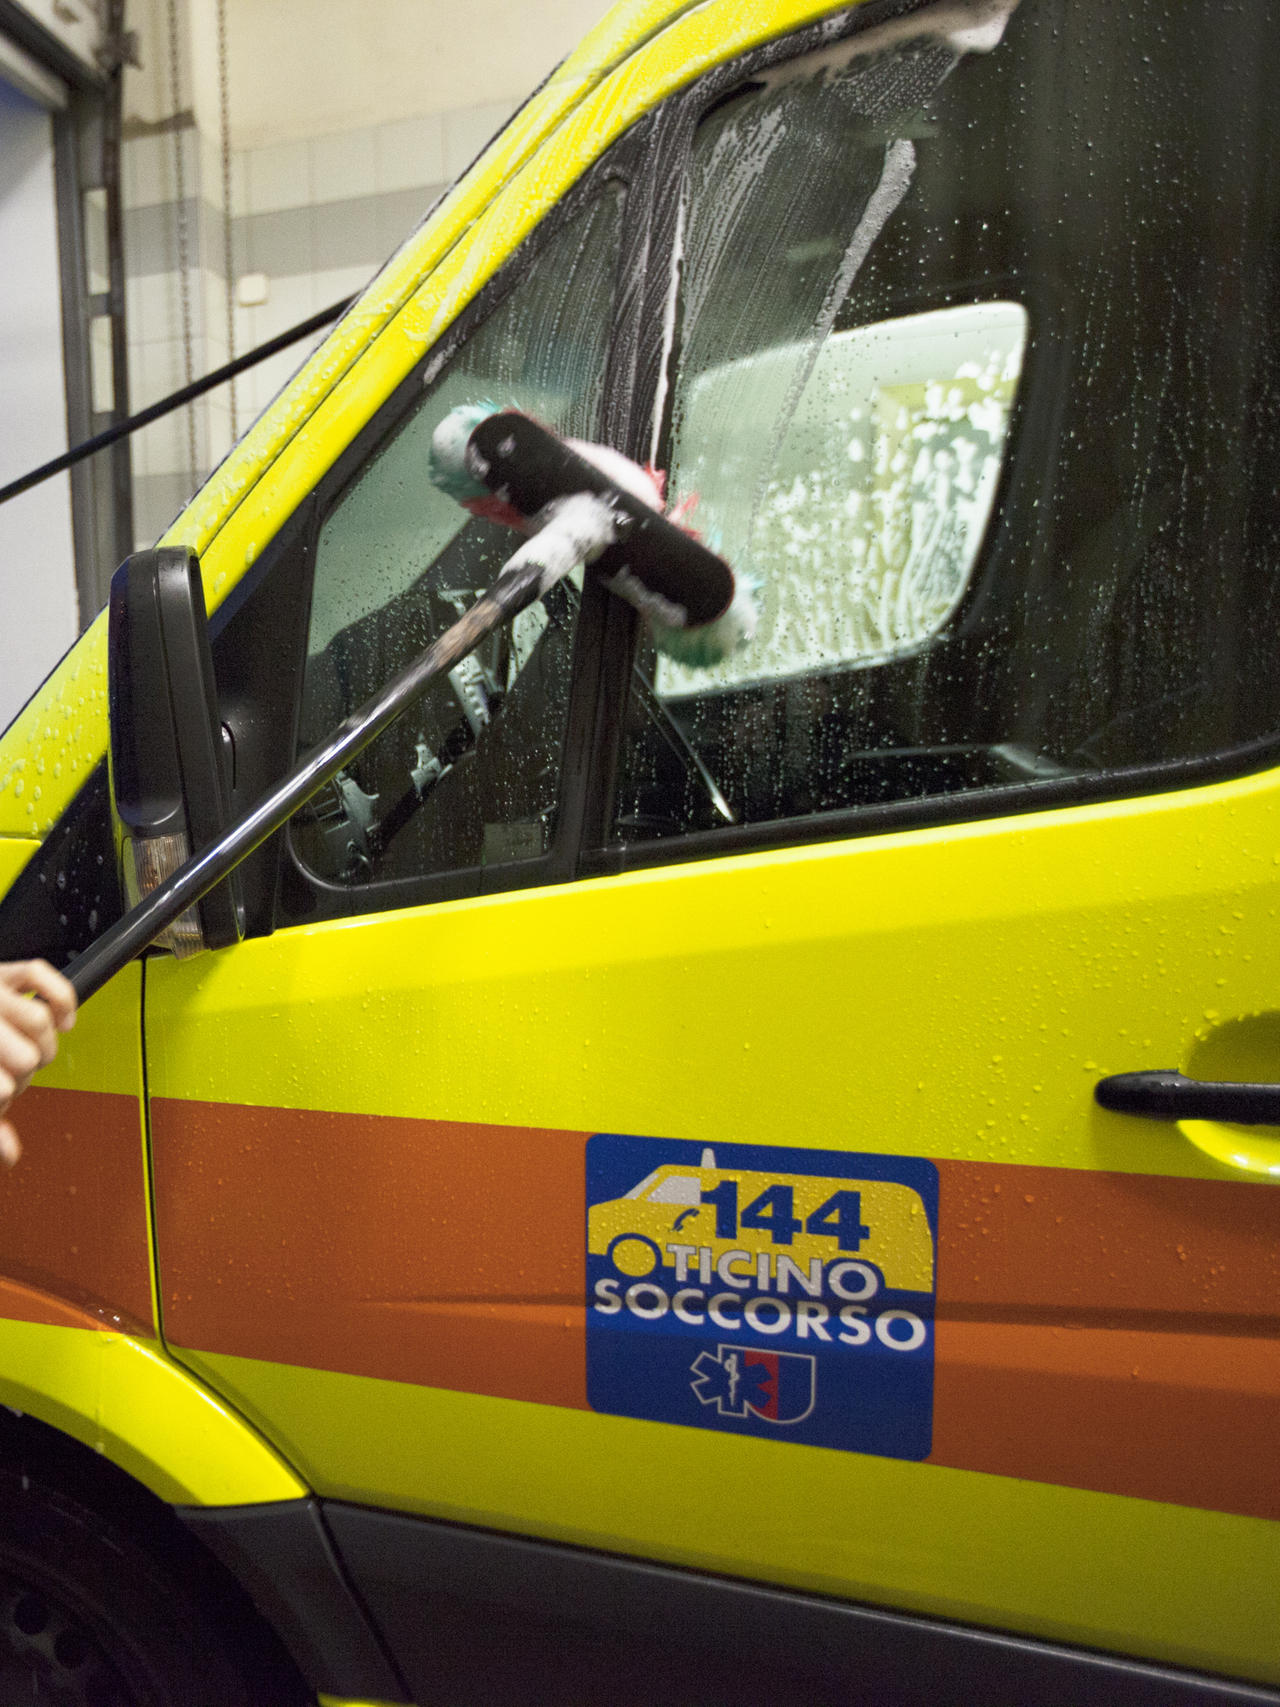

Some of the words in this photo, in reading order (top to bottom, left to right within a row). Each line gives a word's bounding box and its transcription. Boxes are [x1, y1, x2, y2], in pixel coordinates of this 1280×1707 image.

[700, 1179, 870, 1252] 144
[667, 1243, 879, 1301] TICINO
[593, 1278, 927, 1352] SOCCORSO
